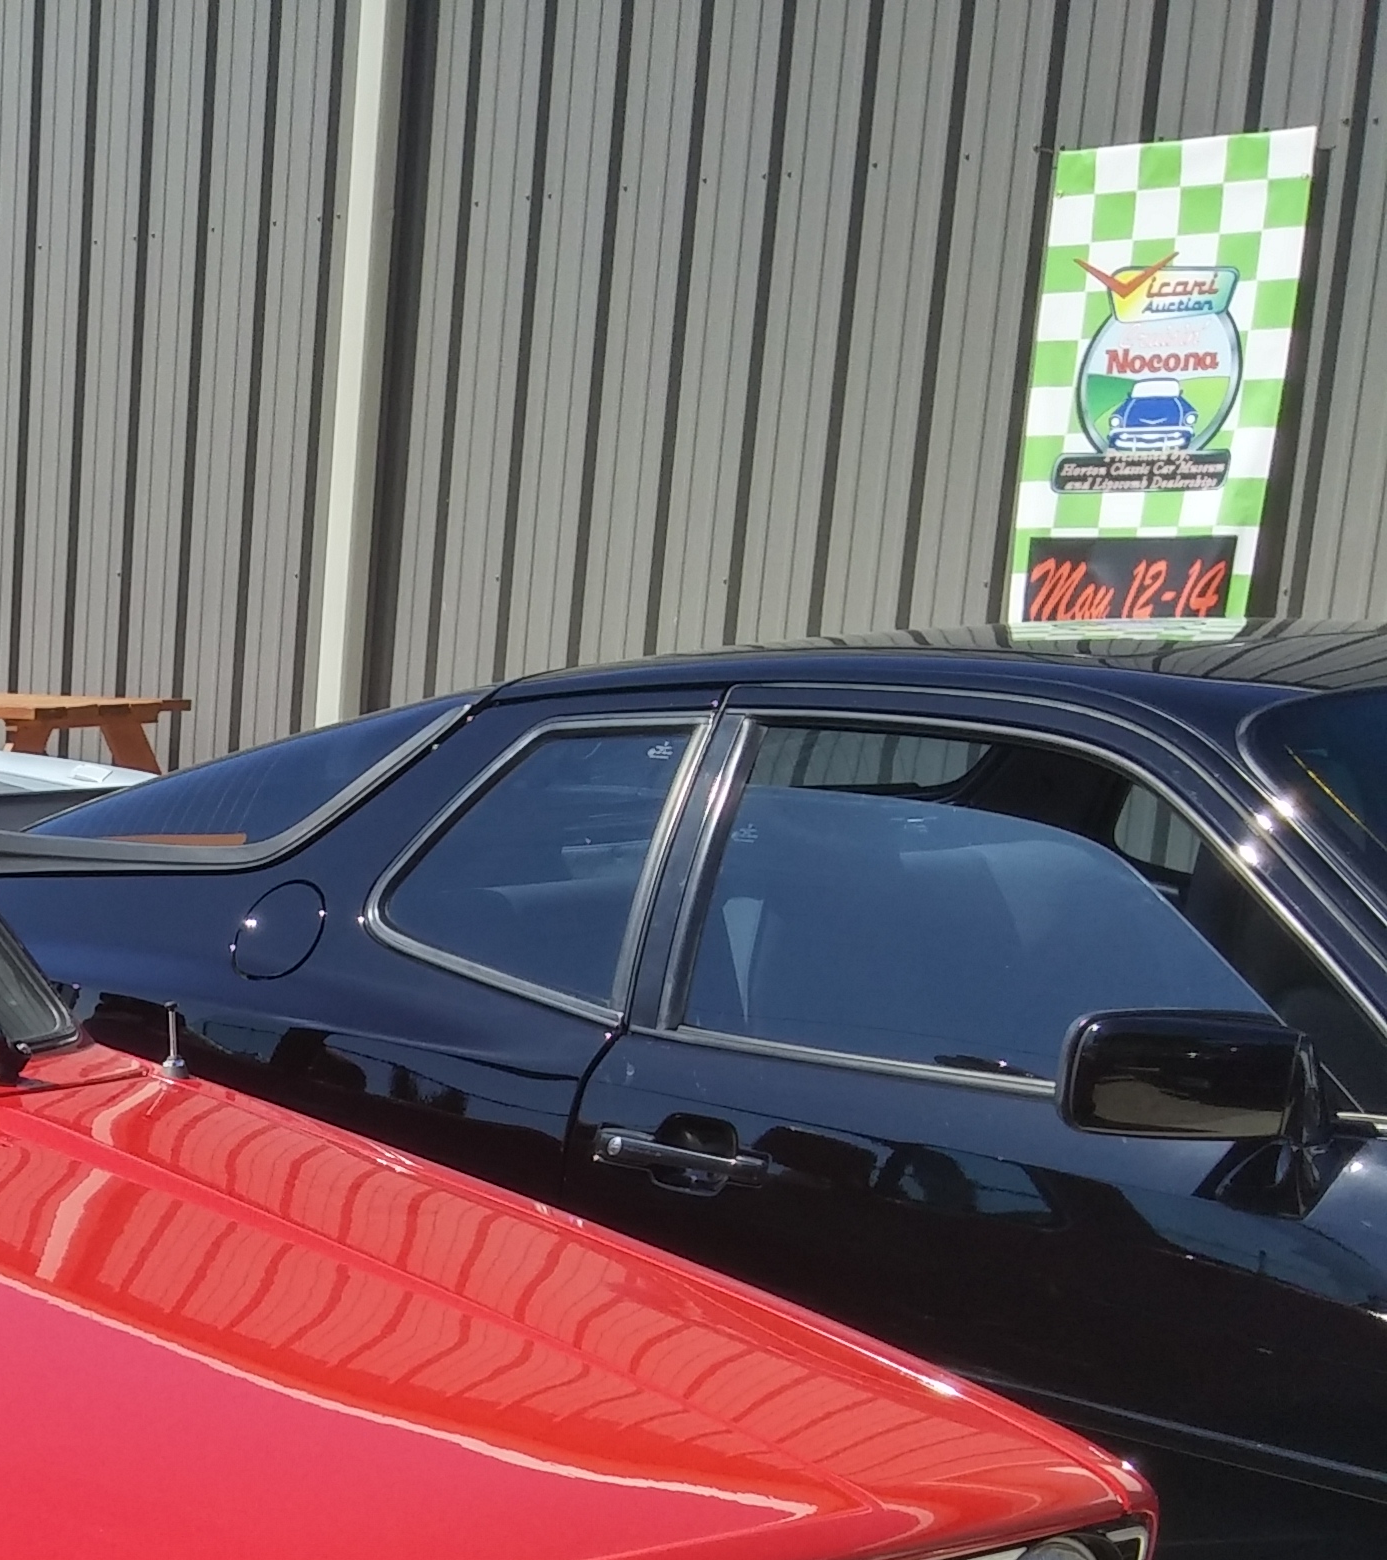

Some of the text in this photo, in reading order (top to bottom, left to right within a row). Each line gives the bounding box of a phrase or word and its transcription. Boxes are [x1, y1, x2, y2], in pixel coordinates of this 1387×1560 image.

[1141, 297, 1214, 314] Auction
[1105, 349, 1219, 375] Nocona
[1109, 461, 1150, 476] Classic
[1152, 461, 1175, 475] Car
[1176, 460, 1226, 474] Museum
[1063, 477, 1090, 490] and
[1030, 557, 1227, 622] May 12-14
